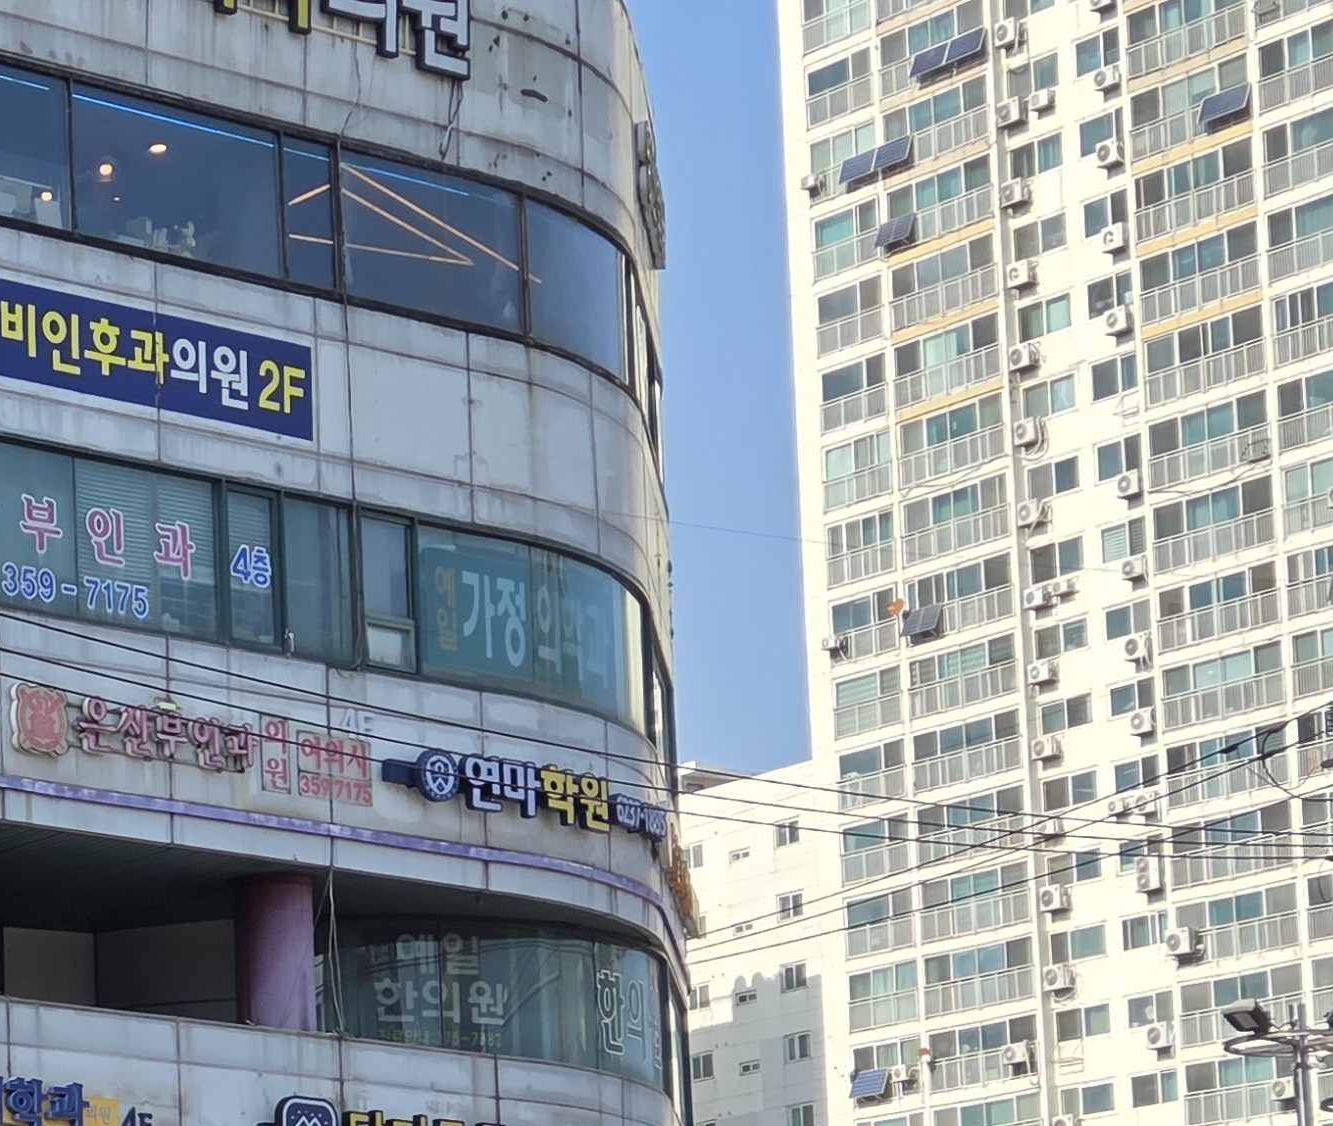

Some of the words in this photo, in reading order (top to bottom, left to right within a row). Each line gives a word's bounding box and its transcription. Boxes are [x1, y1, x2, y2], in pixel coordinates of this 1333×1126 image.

[257, 360, 307, 414] 2F
[230, 543, 273, 590] 4층
[77, 697, 260, 771] 은산부인과
[465, 756, 611, 832] 연마학원
[373, 978, 505, 1026] 한의원
